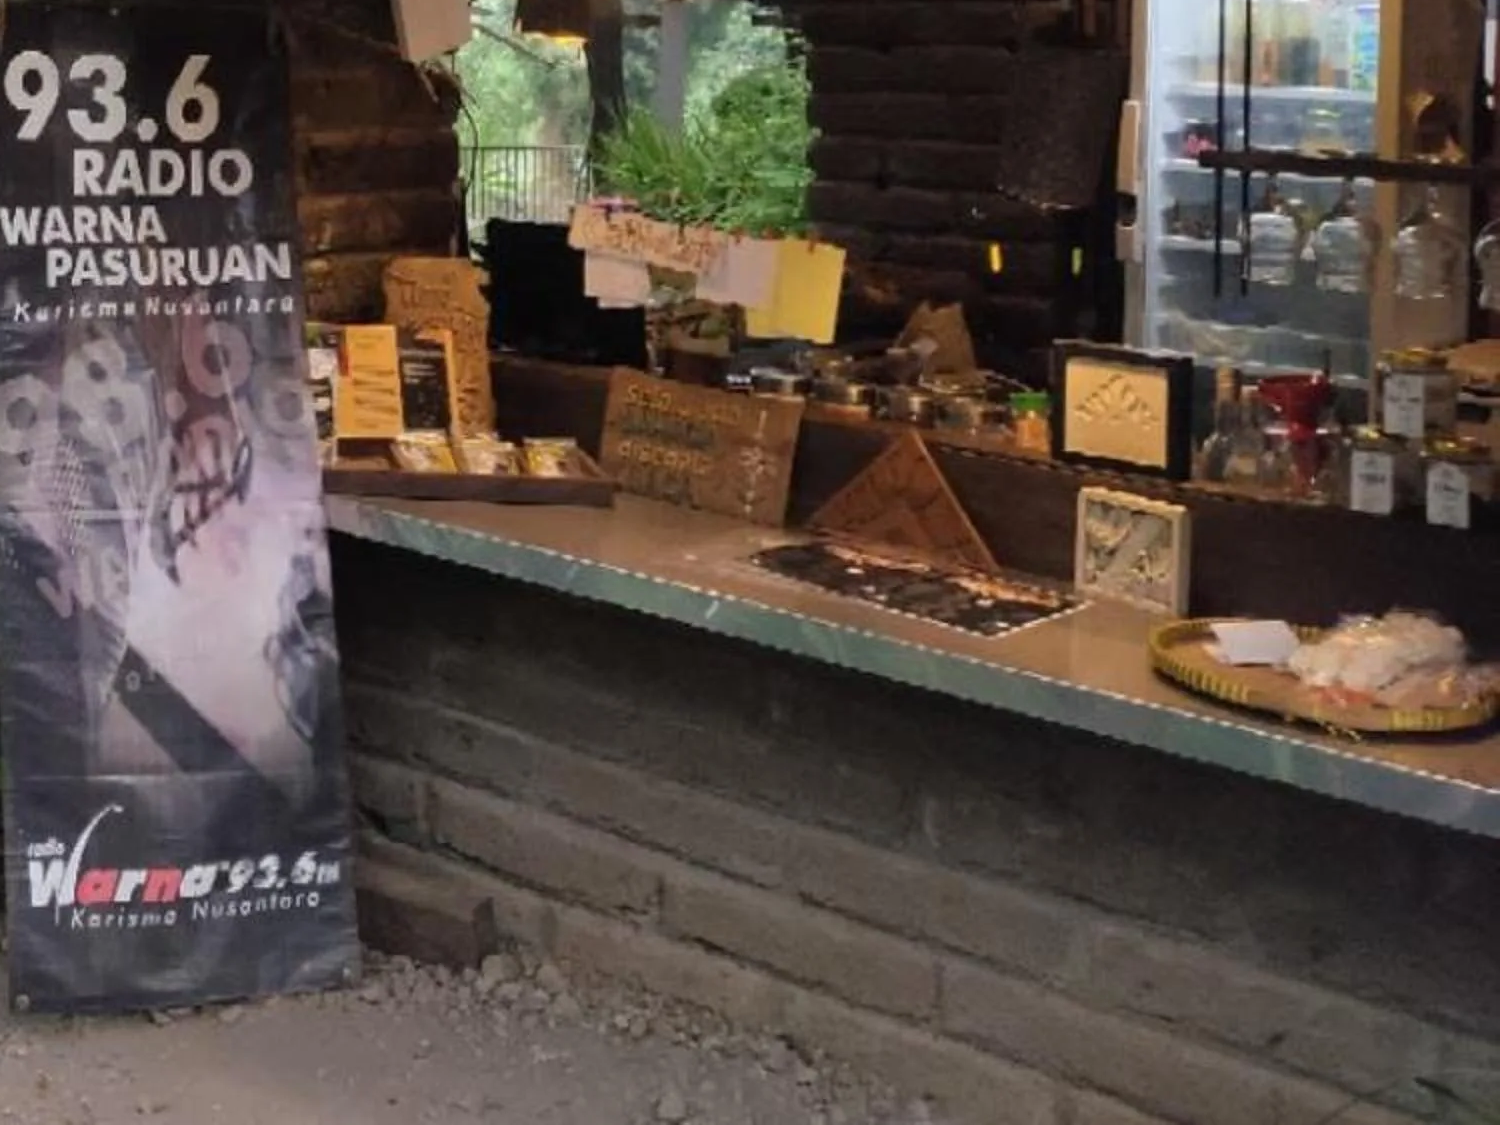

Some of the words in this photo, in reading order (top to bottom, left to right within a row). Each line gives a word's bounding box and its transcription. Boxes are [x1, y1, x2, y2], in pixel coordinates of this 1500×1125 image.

[4, 49, 221, 143] 93.6
[72, 148, 254, 197] RADIO
[46, 241, 293, 288] PASURUAN
[70, 906, 177, 929] Karisma
[191, 890, 320, 921] Nusantara
